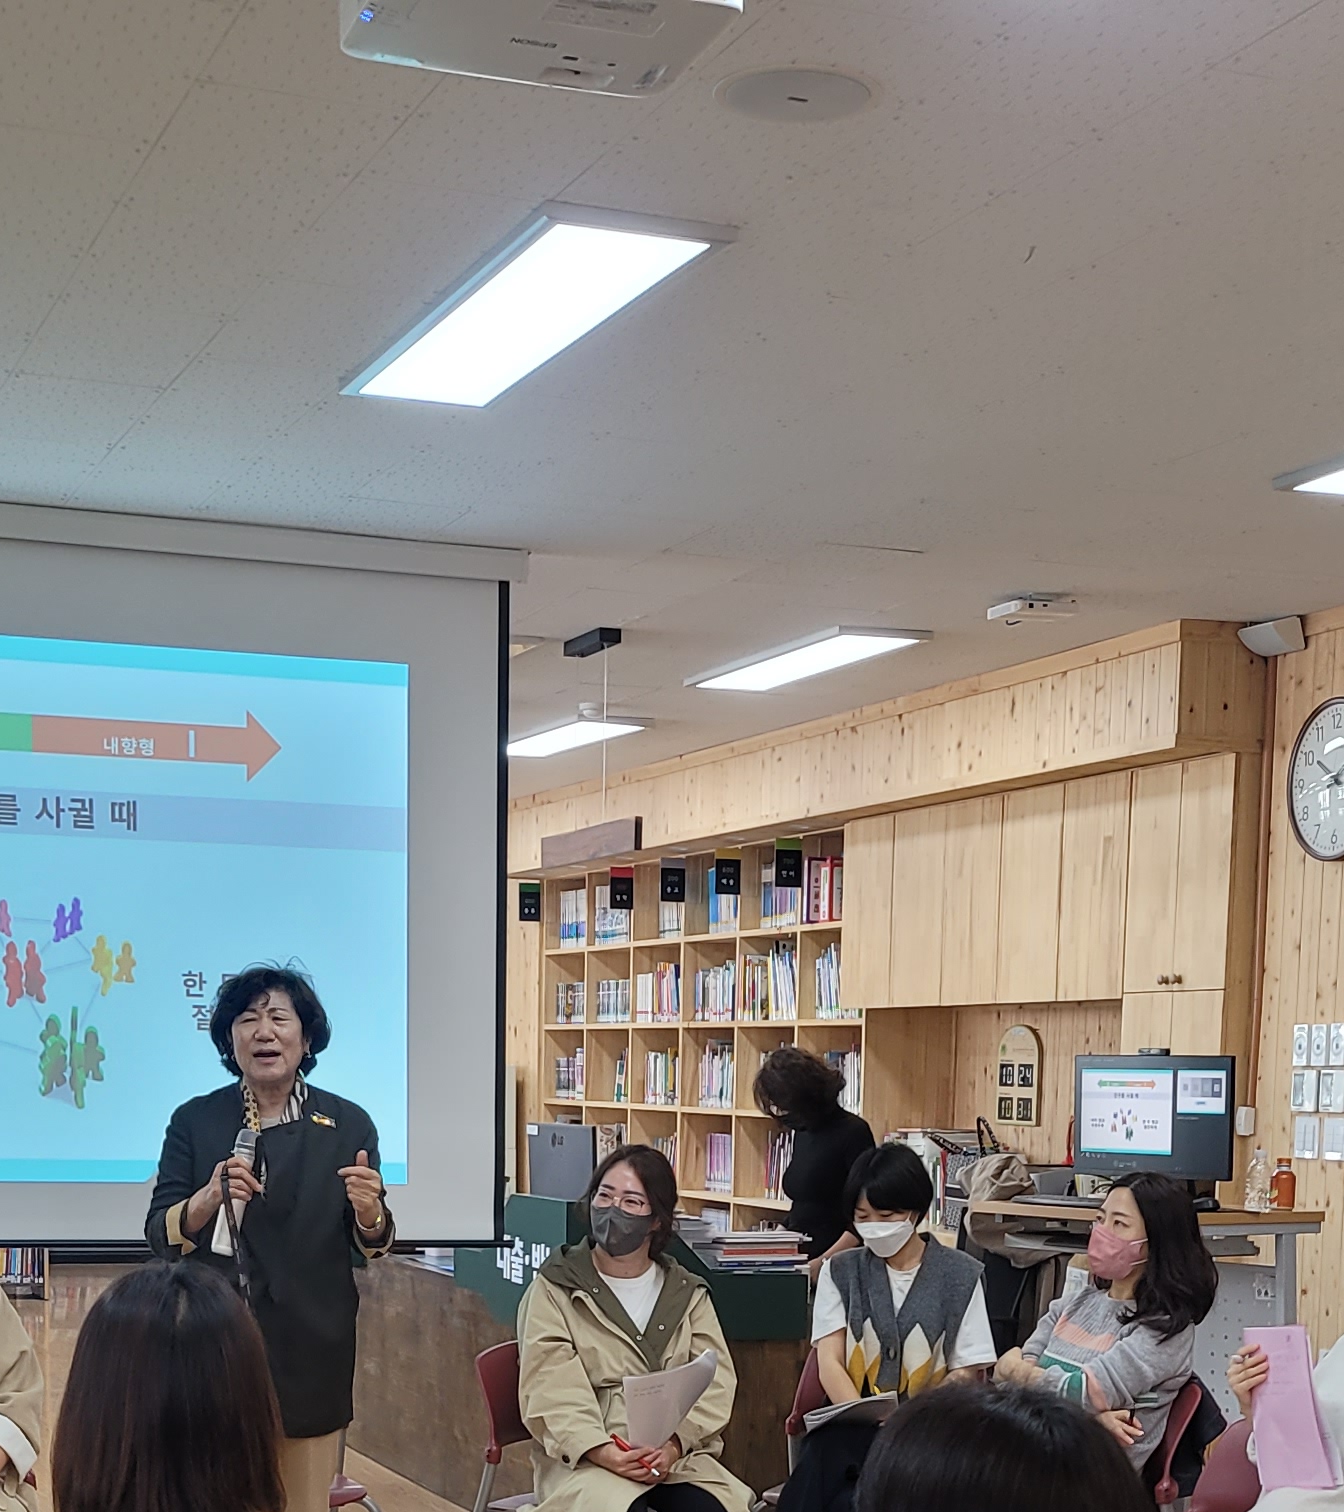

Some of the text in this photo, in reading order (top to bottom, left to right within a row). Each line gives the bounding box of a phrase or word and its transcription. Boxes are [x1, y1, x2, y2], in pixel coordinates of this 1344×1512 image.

[510, 37, 558, 49] EPSON
[1332, 712, 1343, 730] 12
[1316, 725, 1325, 743] 11
[103, 736, 155, 757] 내향형
[1304, 750, 1315, 767] 10
[1298, 778, 1305, 796] 9
[34, 795, 95, 830] 사귈
[109, 799, 138, 832] 때
[1302, 805, 1309, 822] 8
[1313, 823, 1321, 842] 7
[1331, 829, 1338, 845] 6
[181, 969, 208, 998] 한
[1002, 1066, 1032, 1085] 10 24
[1001, 1100, 1031, 1119] 10 31
